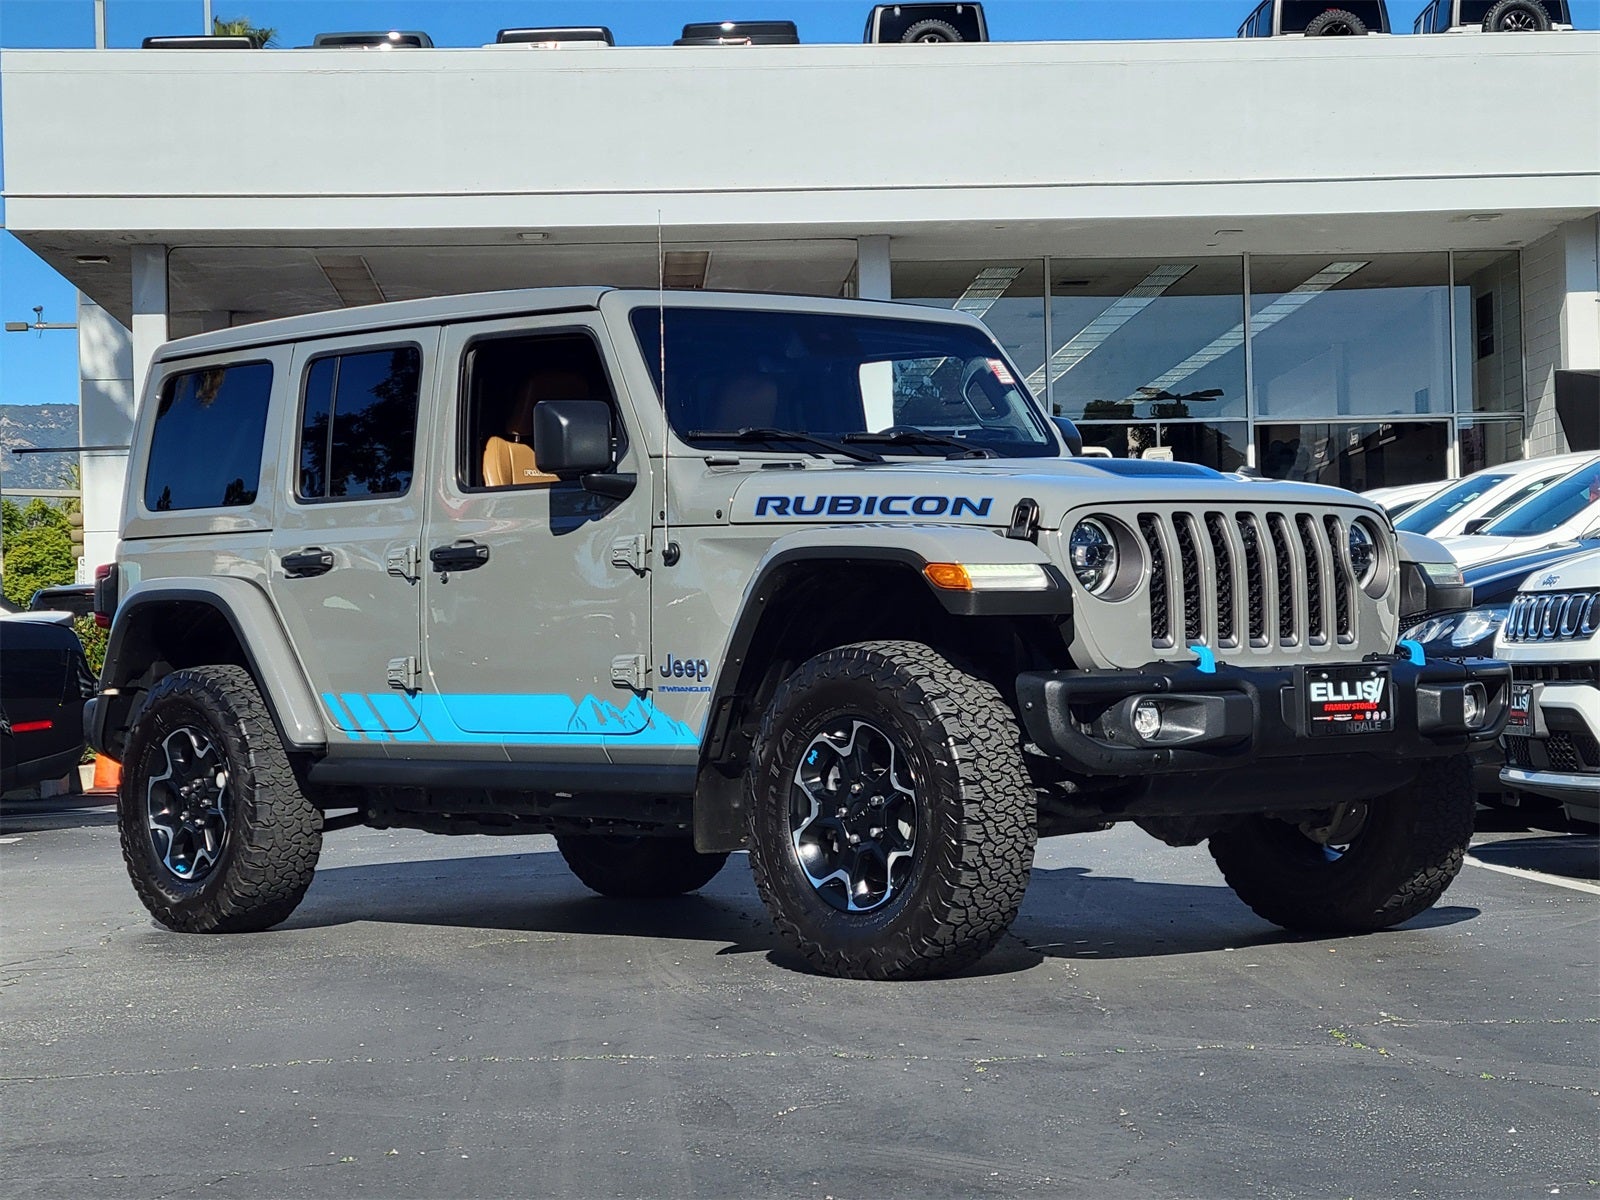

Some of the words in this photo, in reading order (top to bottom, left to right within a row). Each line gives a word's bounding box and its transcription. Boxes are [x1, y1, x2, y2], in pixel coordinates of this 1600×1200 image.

[755, 495, 993, 517] RUBICON
[660, 654, 709, 682] Jeep
[1310, 680, 1377, 702] ELLIS
